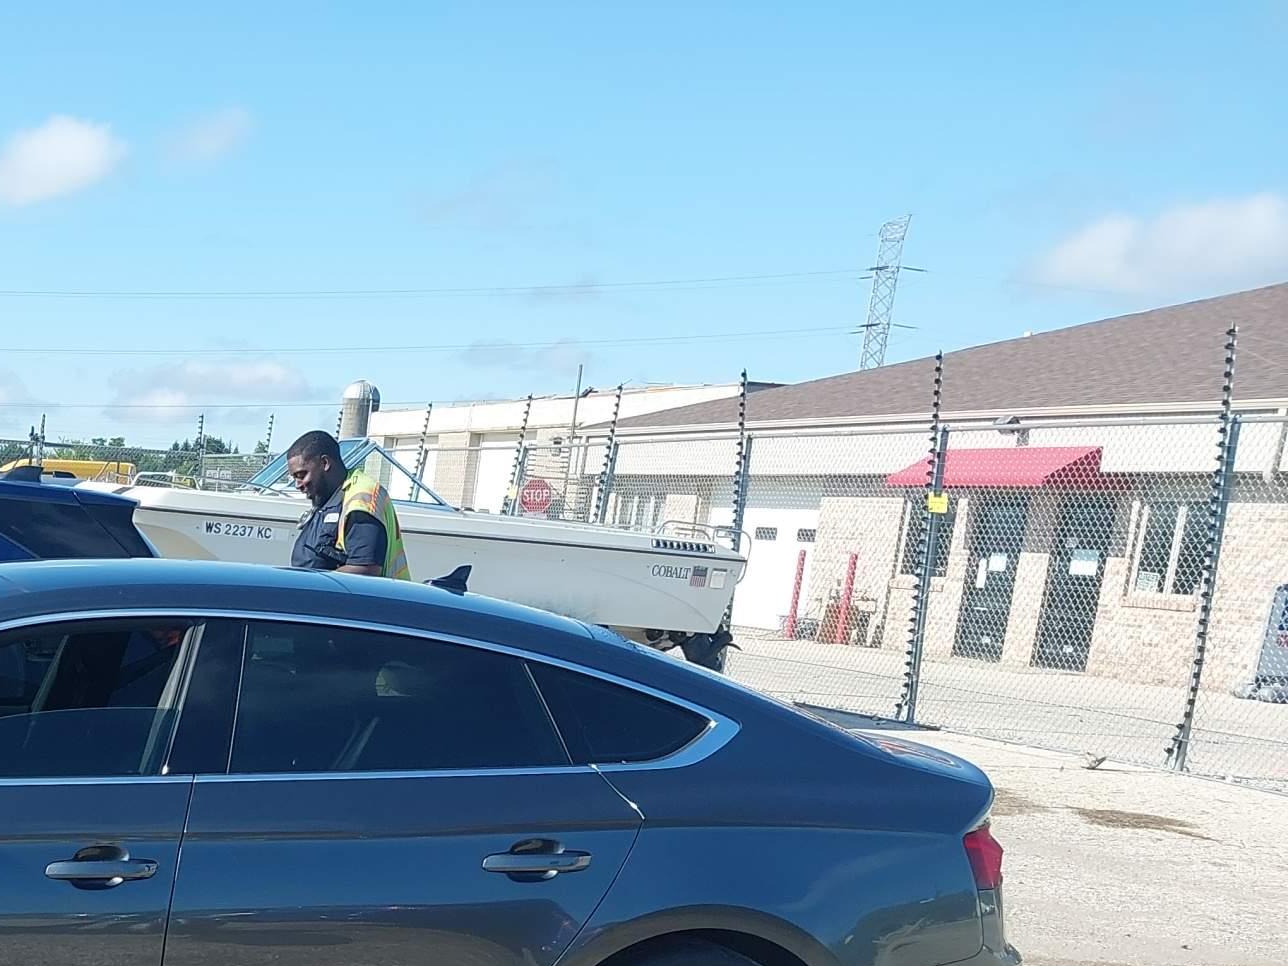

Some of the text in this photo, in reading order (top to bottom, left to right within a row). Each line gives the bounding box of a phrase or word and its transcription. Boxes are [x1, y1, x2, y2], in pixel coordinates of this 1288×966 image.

[523, 489, 551, 502] STOP
[205, 521, 272, 539] WS 2237 KC
[652, 564, 691, 580] COBALT
